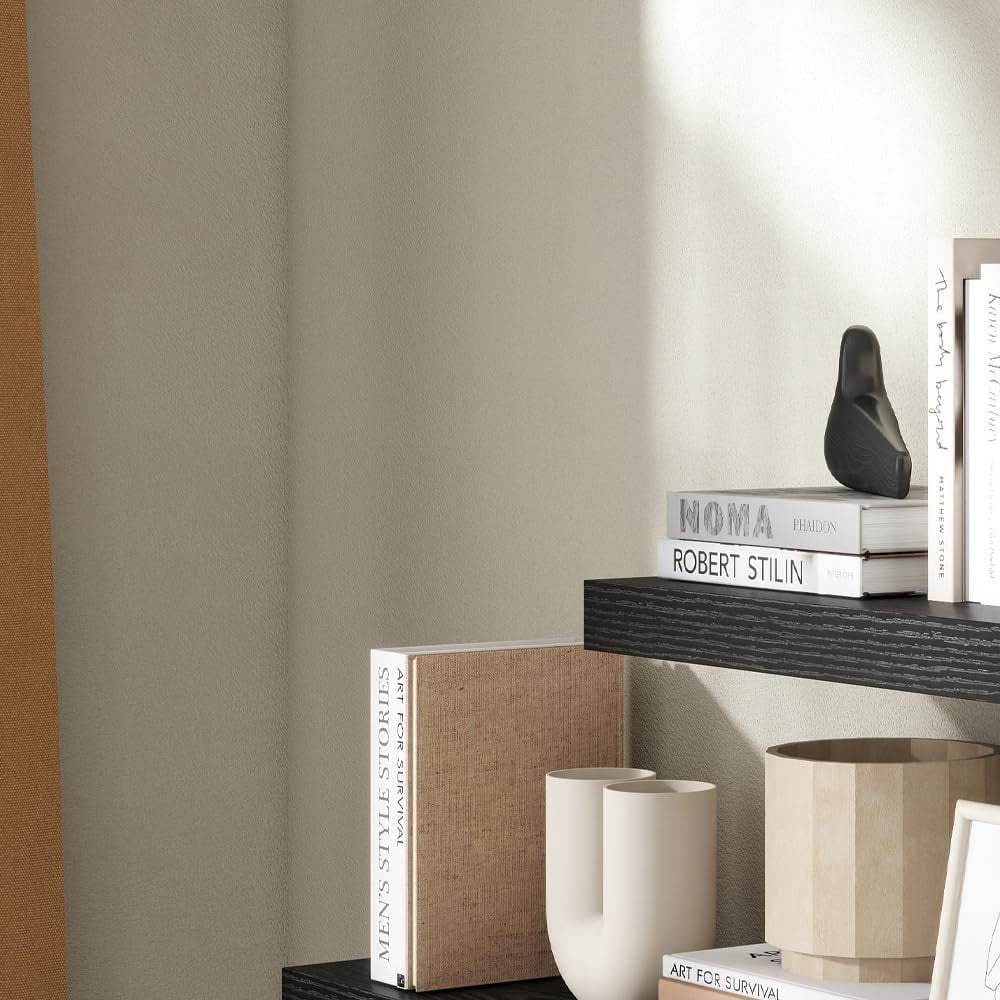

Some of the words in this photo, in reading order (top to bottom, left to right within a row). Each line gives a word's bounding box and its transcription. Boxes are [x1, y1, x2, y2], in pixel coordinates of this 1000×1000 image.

[936, 268, 948, 312] The
[929, 379, 949, 450] beyond
[679, 498, 774, 539] NOMA
[792, 518, 839, 534] PHAIDON
[673, 548, 741, 578] ROBERT
[747, 555, 804, 585] STILIN
[396, 667, 404, 704] ART
[378, 666, 390, 780] STORIES
[396, 712, 404, 751] FOR
[396, 759, 404, 847] SURVIVAL
[378, 788, 390, 873] STYLE
[378, 879, 390, 962] MEN'S
[670, 963, 692, 980] ART
[696, 968, 721, 988] FOR
